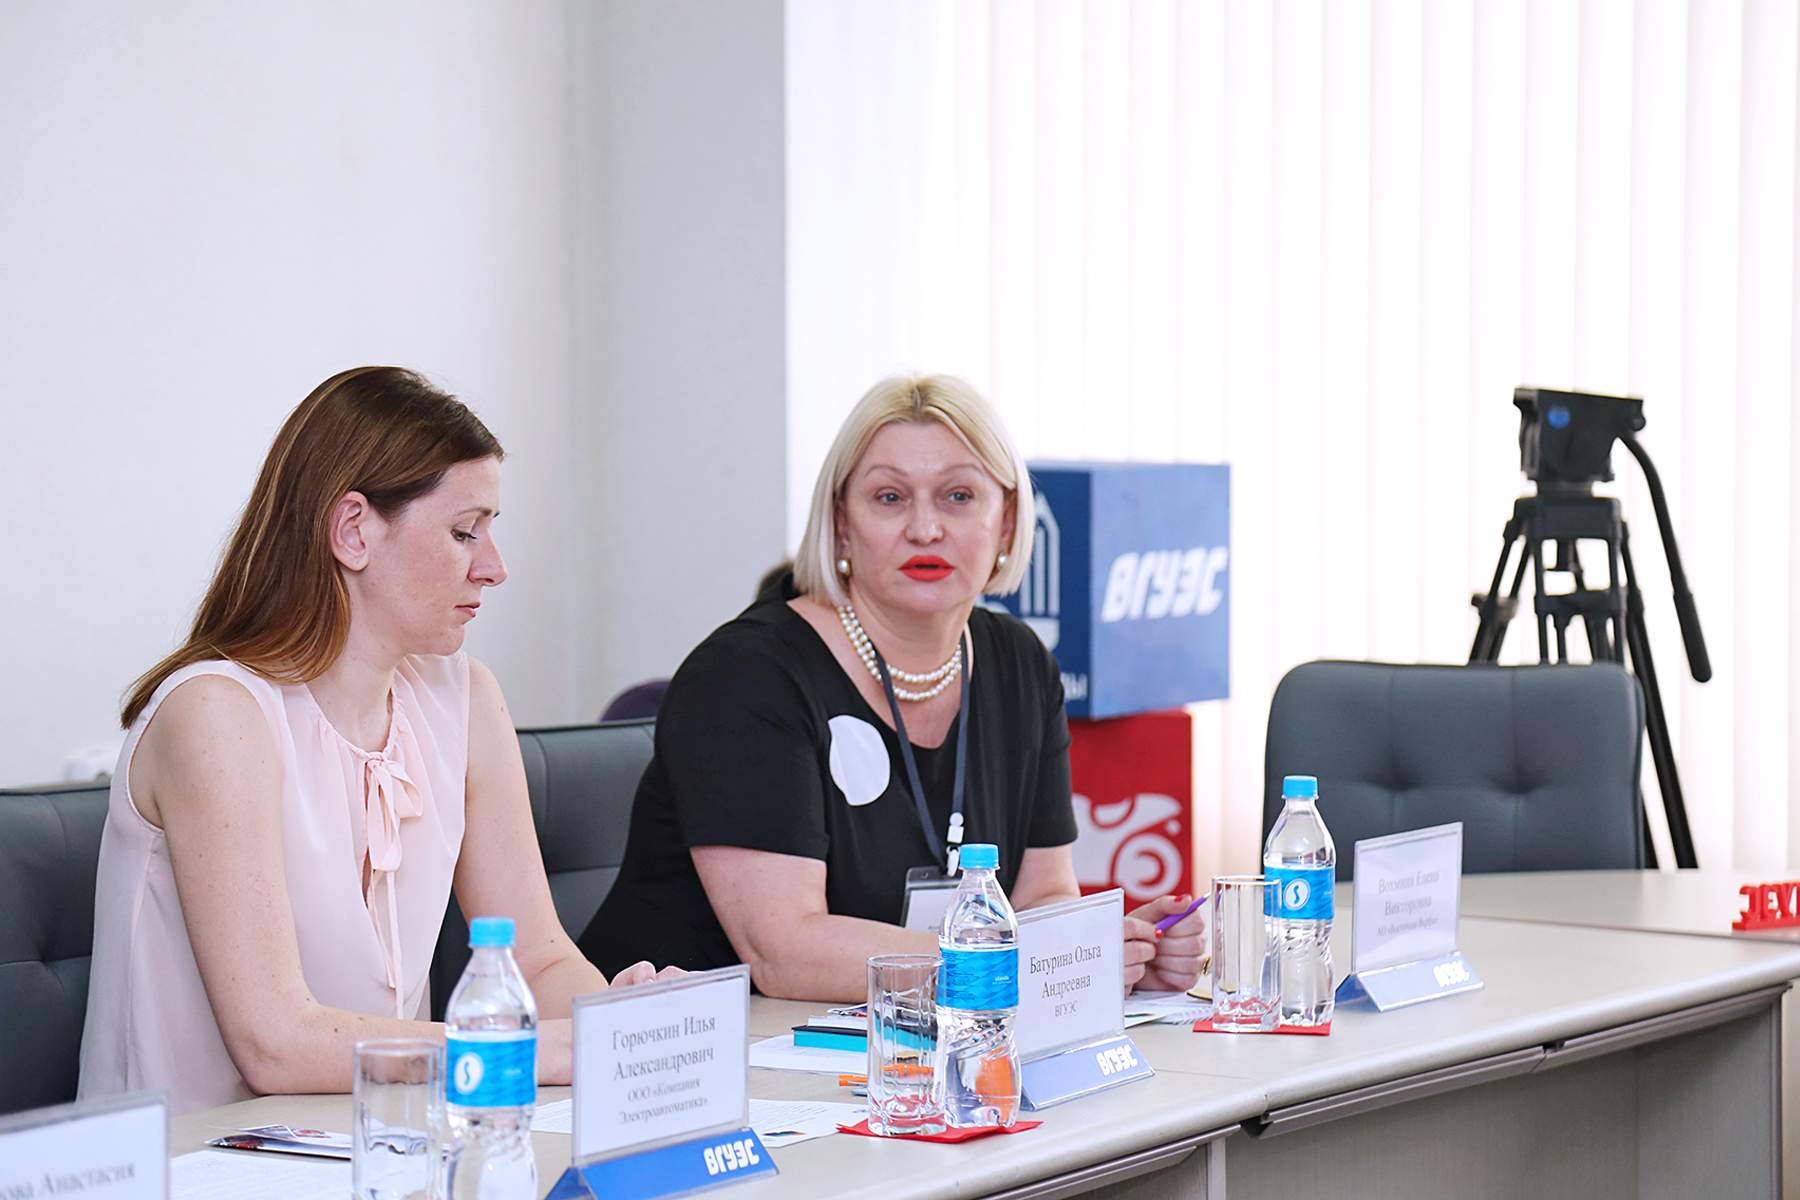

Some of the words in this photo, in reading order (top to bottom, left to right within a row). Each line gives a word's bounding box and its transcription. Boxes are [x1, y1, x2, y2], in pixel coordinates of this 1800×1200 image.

[1101, 546, 1228, 623] ВГУЭС
[1030, 952, 1073, 975] Батурина
[1074, 944, 1102, 963] Ольга
[1041, 974, 1091, 998] Андреевна
[1054, 1000, 1078, 1017] ВГУЭС
[611, 1023, 680, 1053] Горючкин
[683, 1015, 716, 1036] Илья
[613, 1047, 714, 1080] Александрович
[1095, 1044, 1138, 1077] ВГУЭС
[627, 1085, 651, 1101] ООО
[703, 1138, 760, 1177] ВГУЭС
